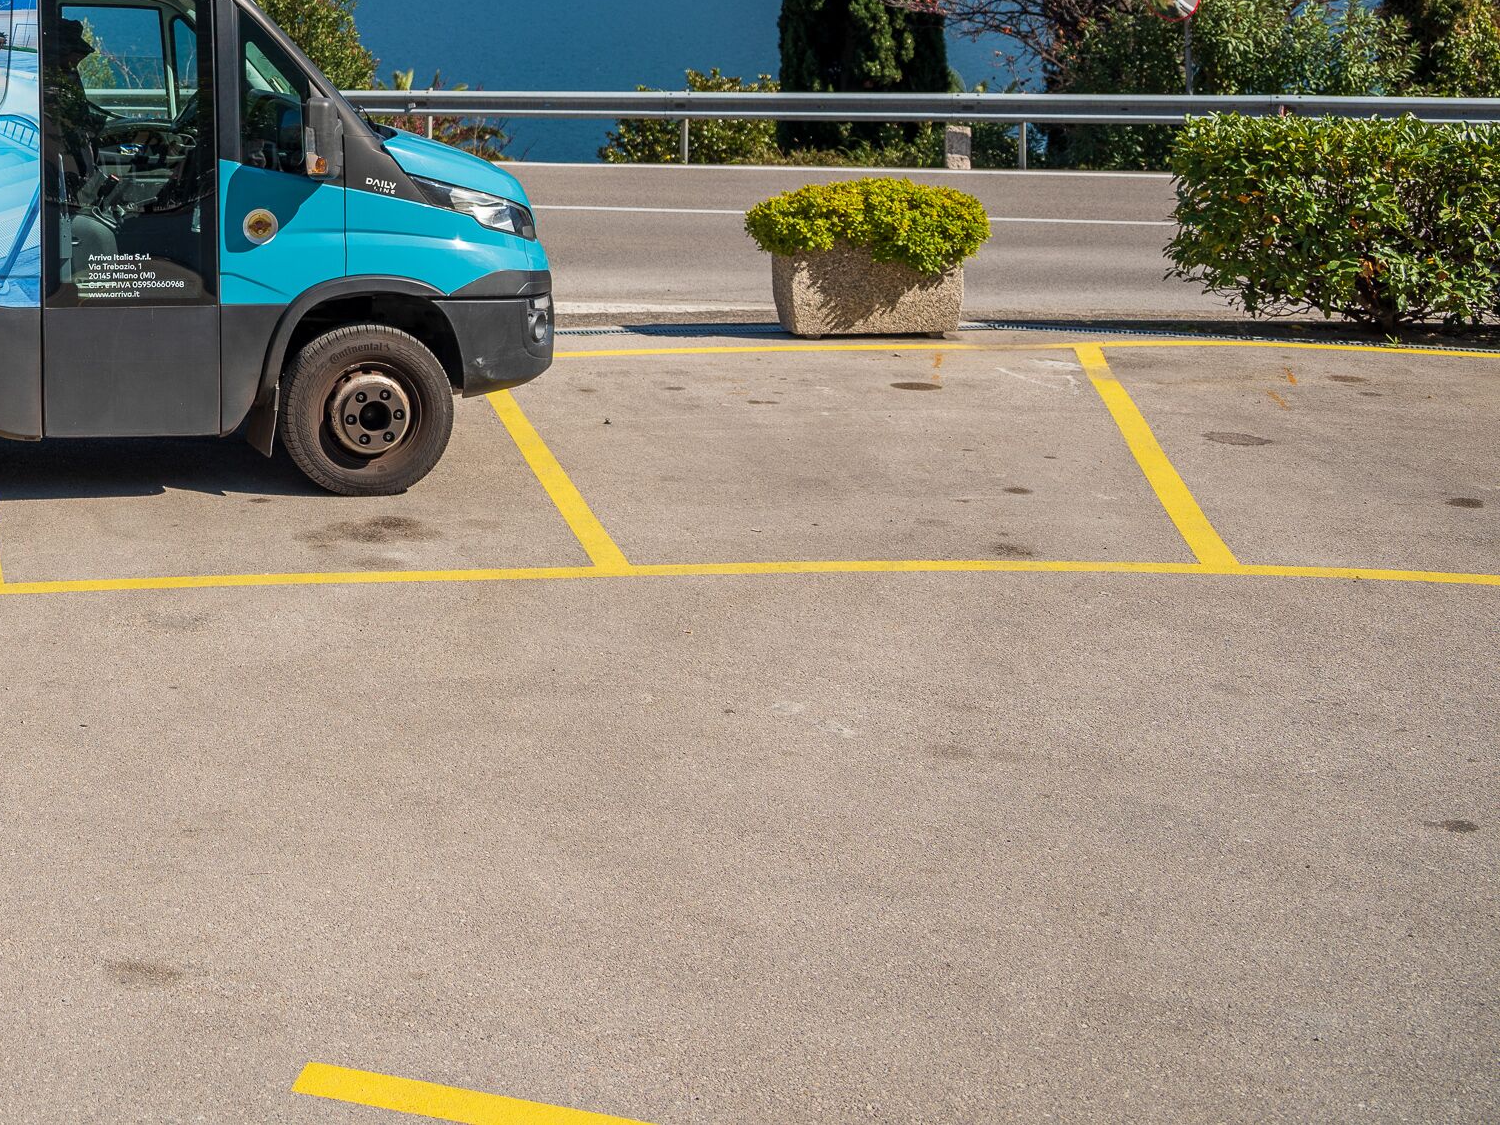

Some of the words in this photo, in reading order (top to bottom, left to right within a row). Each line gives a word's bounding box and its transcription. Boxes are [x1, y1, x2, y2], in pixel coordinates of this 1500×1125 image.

[366, 177, 397, 189] DAILY
[113, 253, 134, 261] Italia
[102, 263, 137, 271] Trebazio,
[88, 272, 111, 280] 20145
[112, 272, 138, 280] Milano
[139, 271, 156, 280] (MI)
[132, 280, 185, 288] 05950660968
[330, 342, 383, 364] Continental
